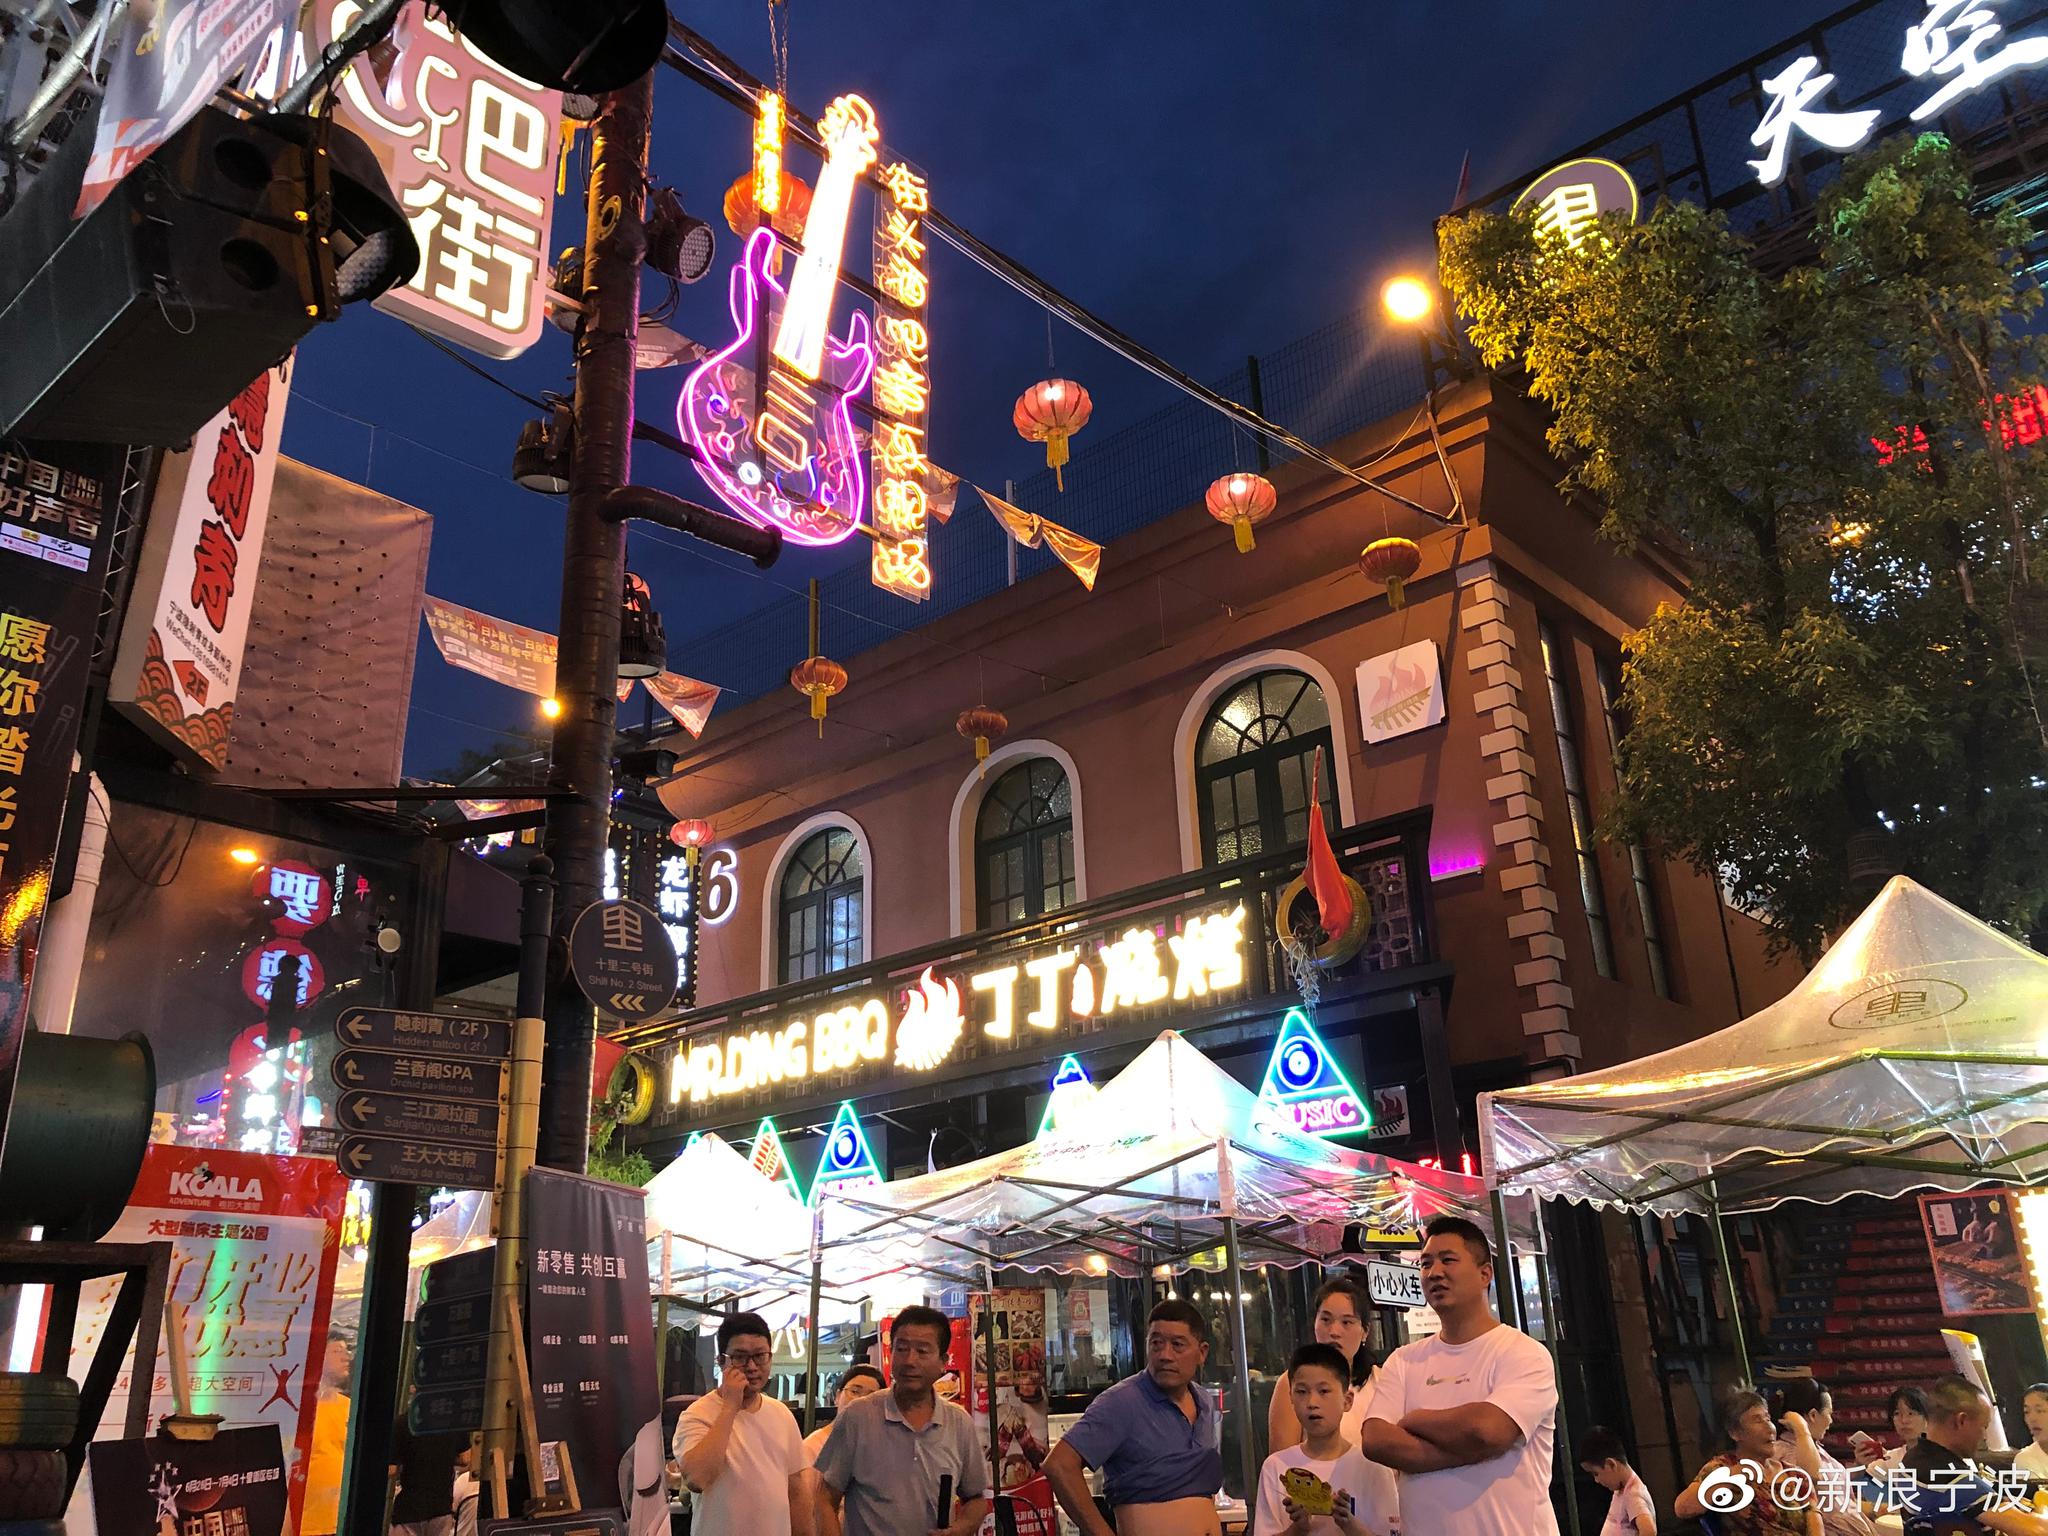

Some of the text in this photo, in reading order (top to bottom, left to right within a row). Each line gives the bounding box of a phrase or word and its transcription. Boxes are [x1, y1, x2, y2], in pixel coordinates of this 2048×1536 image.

[185, 671, 208, 697] 2F
[700, 848, 738, 924] 6
[595, 957, 653, 976] 十里二号街
[589, 976, 607, 985] Shili
[629, 981, 635, 989] 2
[637, 983, 662, 992] Street
[393, 1036, 430, 1046] Hidden
[813, 998, 889, 1074] BBQ
[393, 1059, 473, 1080] 兰香阁SPA
[402, 1100, 479, 1124] 三江源拉面
[1283, 1096, 1357, 1127] USIC
[384, 1115, 496, 1138] Sanjiangyuan Ramen
[402, 1145, 477, 1168] 王大大生煎
[169, 1171, 263, 1201] KOALA
[169, 1197, 210, 1207] ADVENTURE
[147, 1219, 269, 1241] 大型蹦床主题公园
[537, 1248, 627, 1280] 新零售 共创互赢
[1374, 1268, 1423, 1300] 小心火车
[190, 1376, 254, 1393] 超大空间
